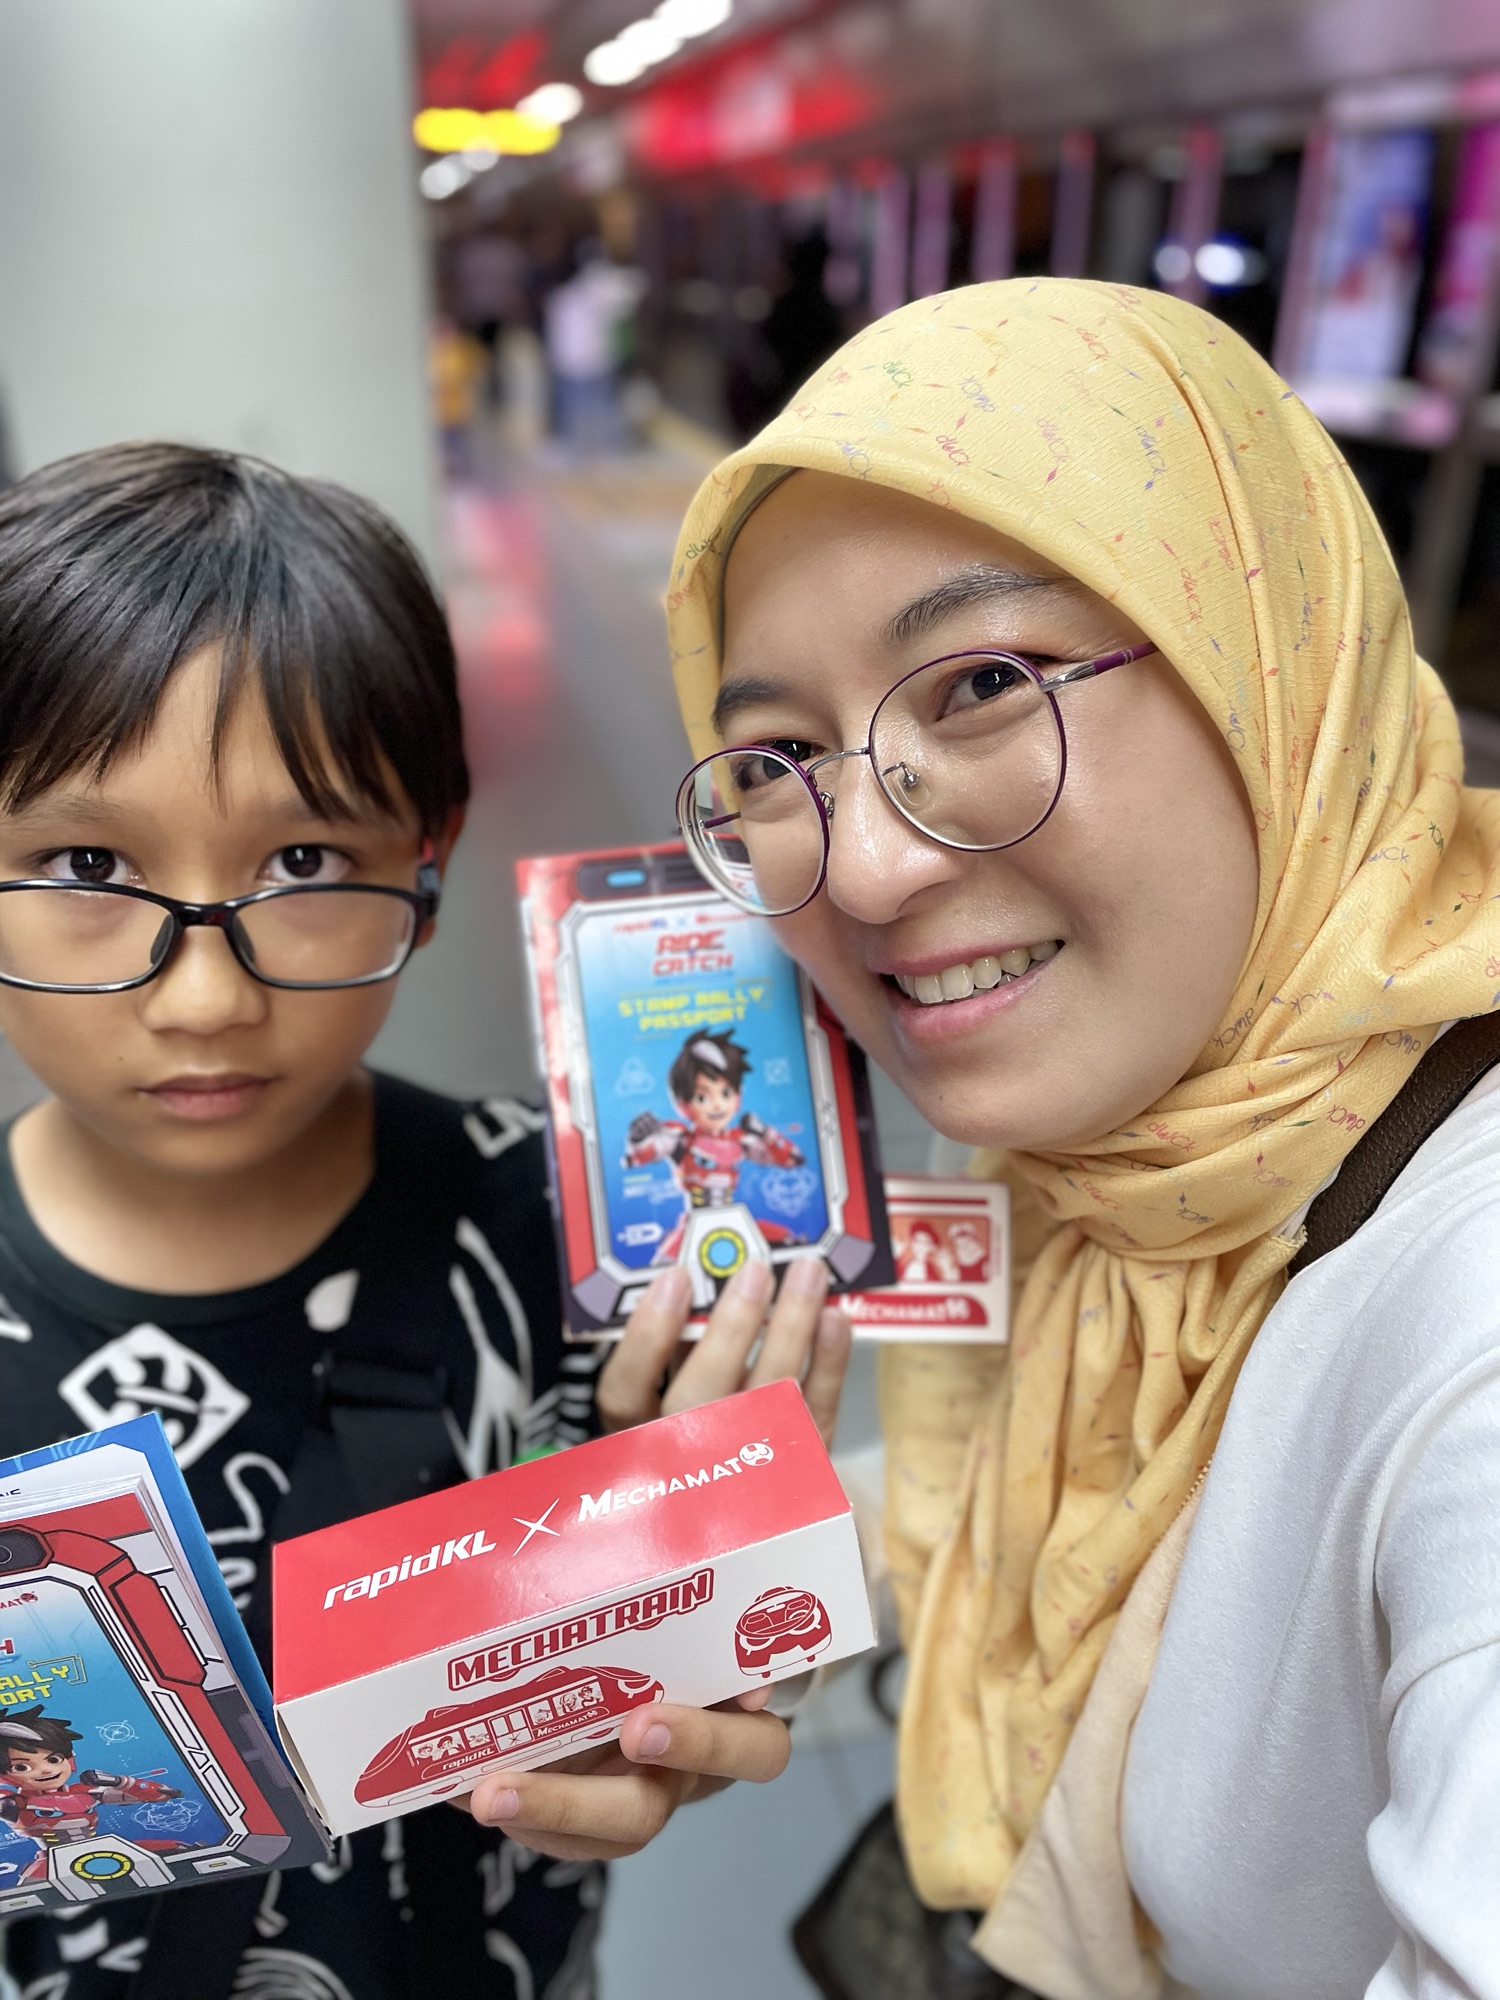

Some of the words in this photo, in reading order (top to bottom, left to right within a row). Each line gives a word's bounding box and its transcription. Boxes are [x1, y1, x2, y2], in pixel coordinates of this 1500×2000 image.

[323, 1529, 498, 1610] rapidKL
[454, 1573, 709, 1687] MECHATRAIN
[442, 1747, 495, 1771] rapidKL
